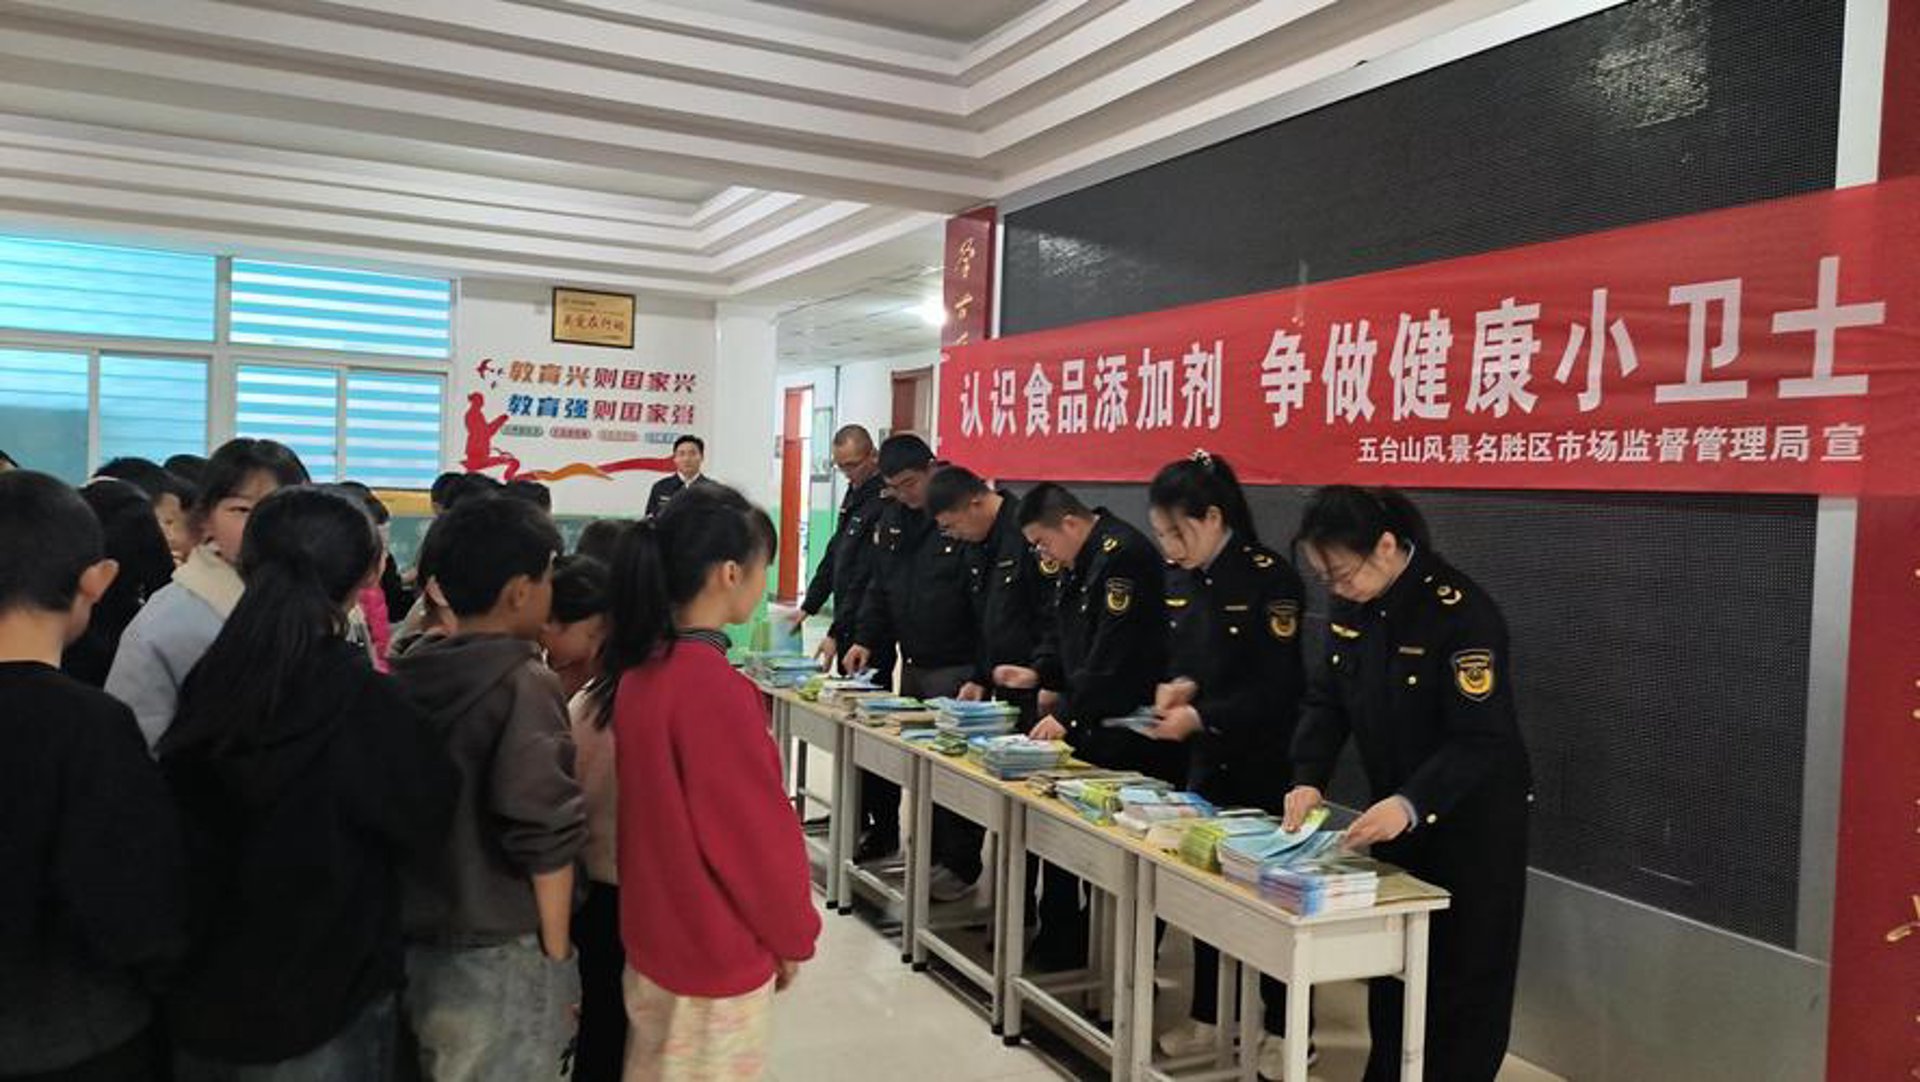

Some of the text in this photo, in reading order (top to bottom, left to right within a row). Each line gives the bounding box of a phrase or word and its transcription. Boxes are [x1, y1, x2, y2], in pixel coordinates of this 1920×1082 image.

[960, 256, 1886, 437] 认识食品添加剂 争做健康小卫士
[509, 360, 697, 393] 教育兴则国家兴
[508, 394, 695, 425] 教育强则国家强
[1357, 424, 1866, 464] 五台山风景名胜区市场监督管理局 宣
